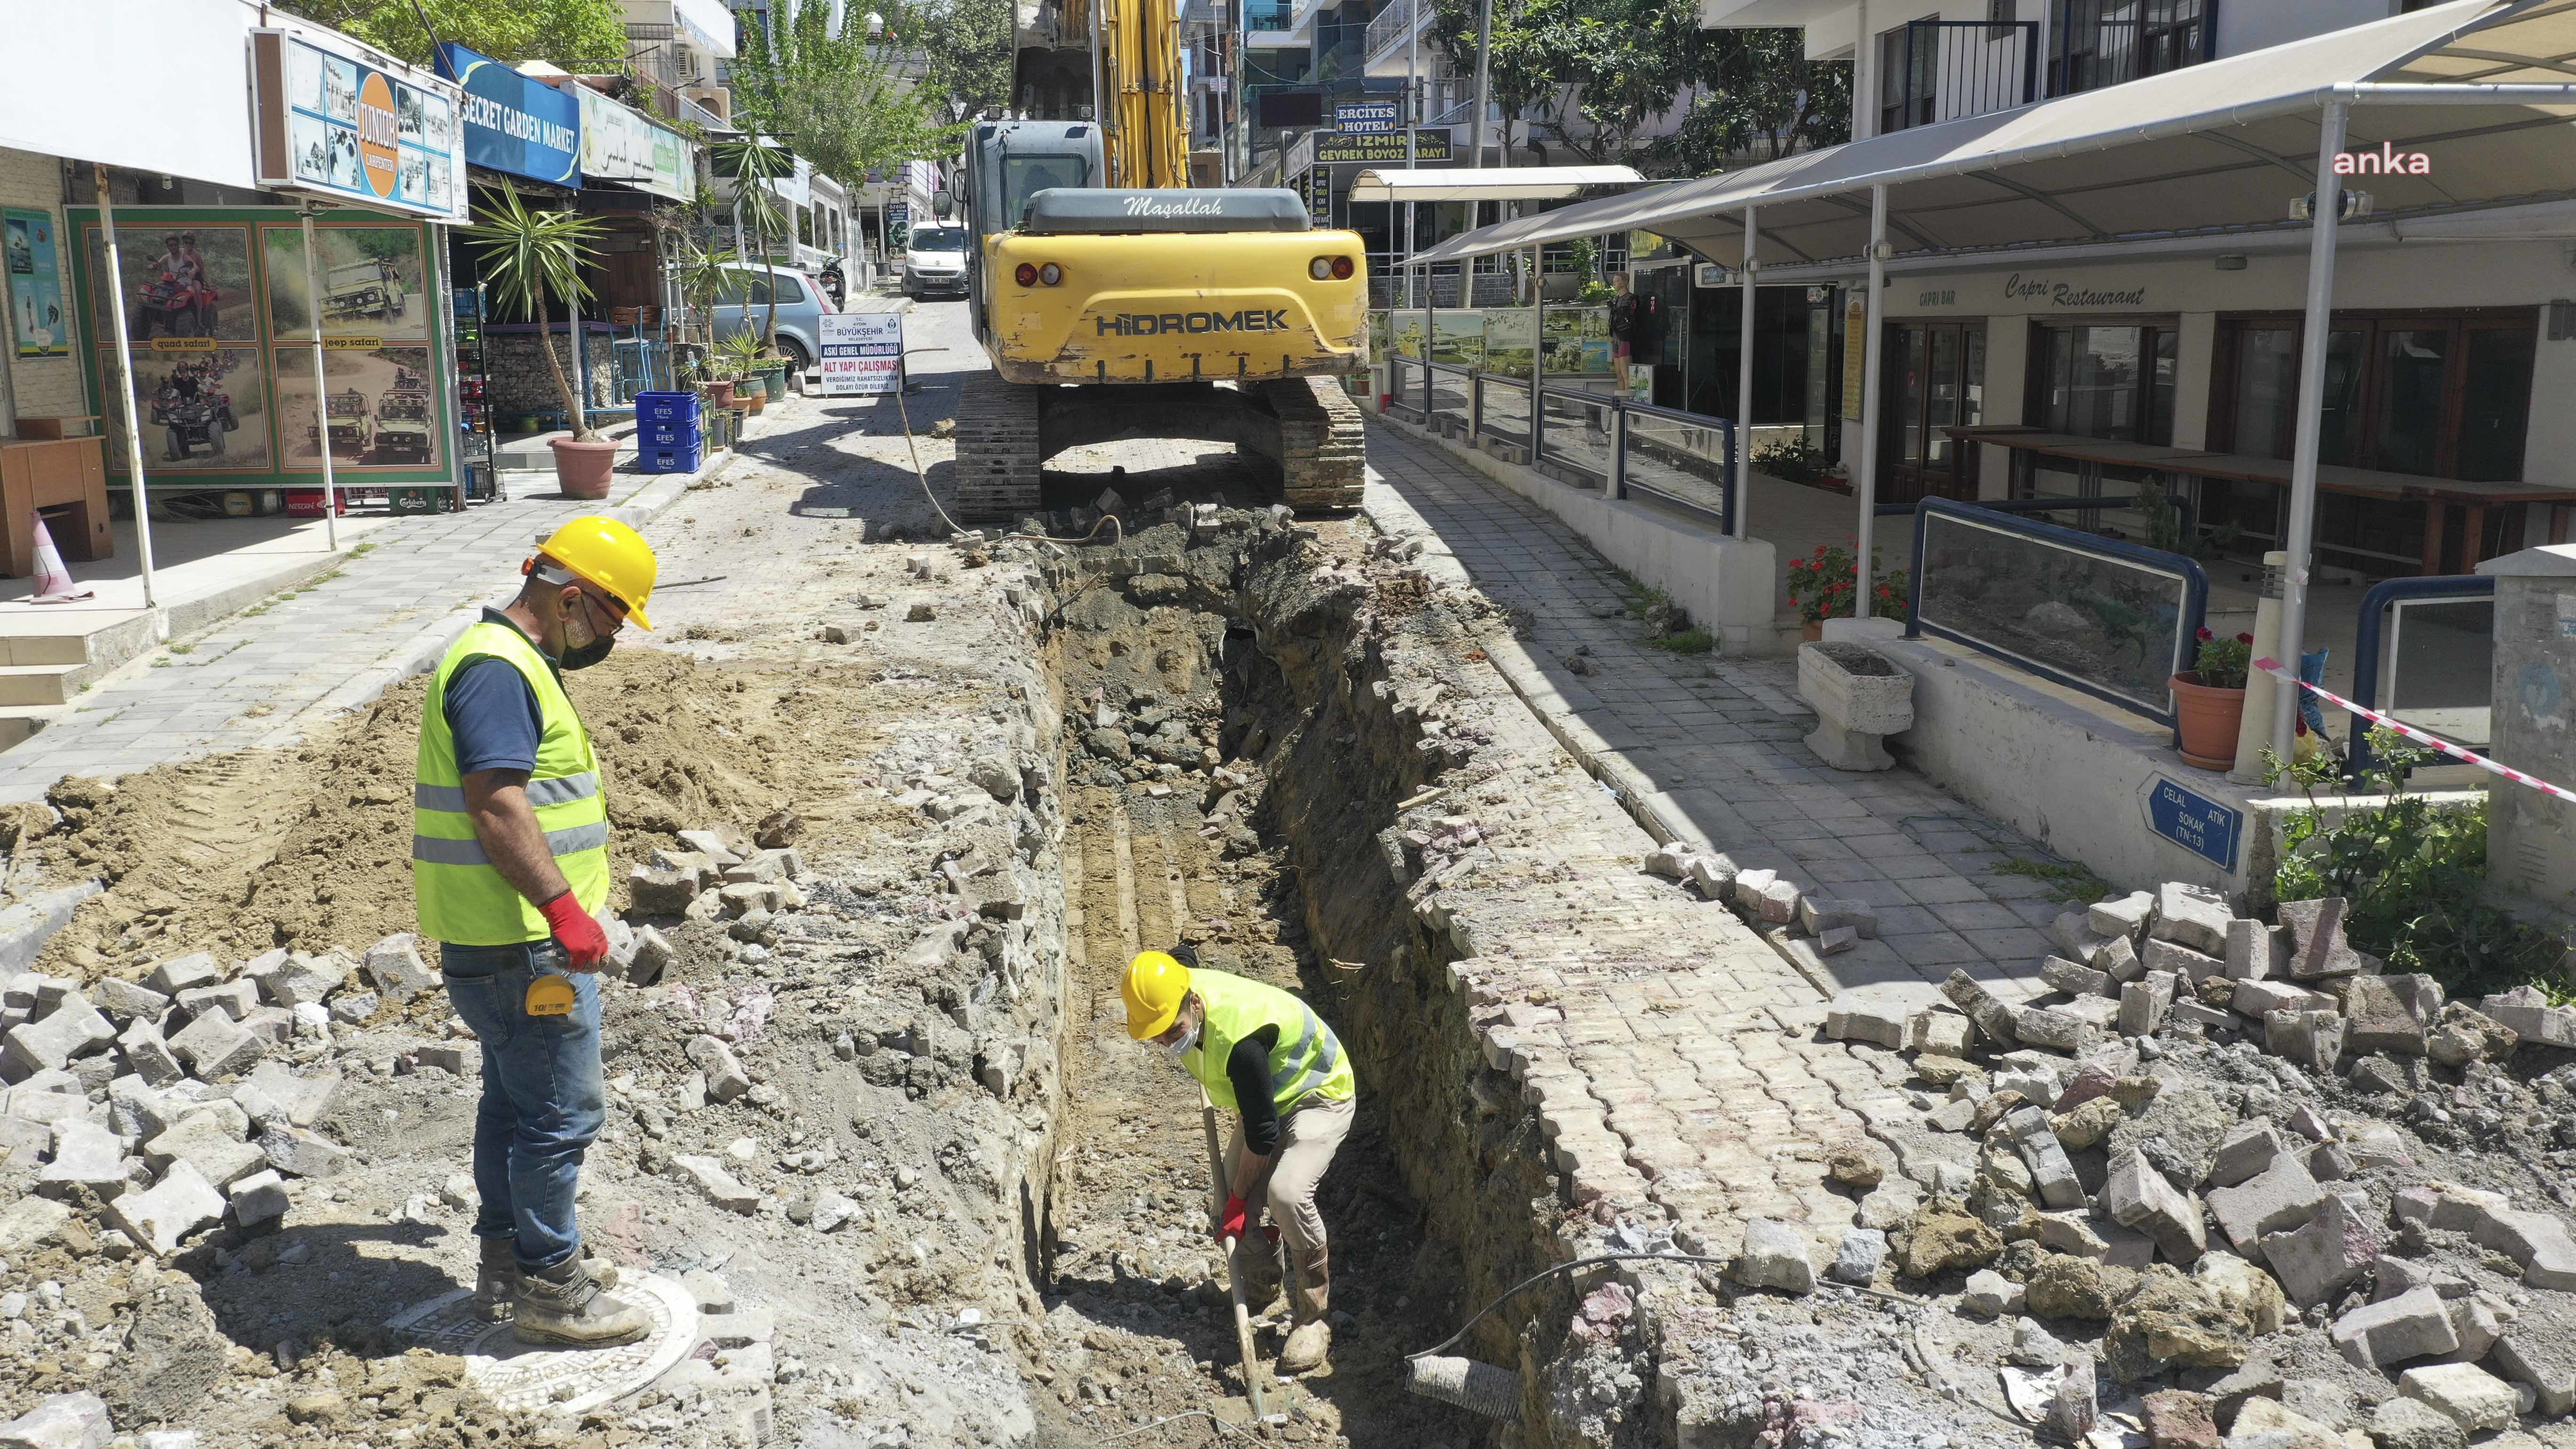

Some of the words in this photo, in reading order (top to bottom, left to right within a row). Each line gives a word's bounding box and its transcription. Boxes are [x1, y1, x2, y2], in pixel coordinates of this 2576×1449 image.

[360, 102, 397, 150] JUNIOR
[462, 93, 502, 131] SECRET
[504, 106, 541, 144] GARDEN
[542, 120, 575, 154] MARKET
[1344, 121, 1388, 132] HOTEL
[1319, 149, 1364, 161] GEVREK
[1367, 148, 1404, 159] BOYOZ
[1415, 147, 1445, 159] ARAYI
[1123, 196, 1223, 219] Maşallah
[2005, 273, 2049, 300] Capri
[2052, 282, 2145, 306] Restaurant
[1919, 292, 1939, 307] CAPRI
[1941, 290, 1956, 306] BAR
[837, 326, 883, 337] BÜYÜKŞEHİR
[157, 339, 181, 349] quad
[184, 339, 210, 347] safari
[325, 338, 347, 347] jeep
[350, 338, 379, 346] safari
[824, 345, 837, 356] ASKİ
[839, 346, 858, 356] GENEL
[860, 344, 898, 355] MÜDÜRLÜĞÜ
[824, 362, 837, 372] ALT
[839, 362, 856, 372] YAPI
[859, 360, 899, 374] ÇALIŞMASI
[289, 501, 316, 510] NESCAFÉ
[399, 498, 427, 508] Carlsberg
[2164, 787, 2186, 808] CELAL
[2207, 809, 2226, 827] ATİK
[2178, 811, 2205, 834] SOKAK
[2176, 826, 2204, 851] (TN:13)
